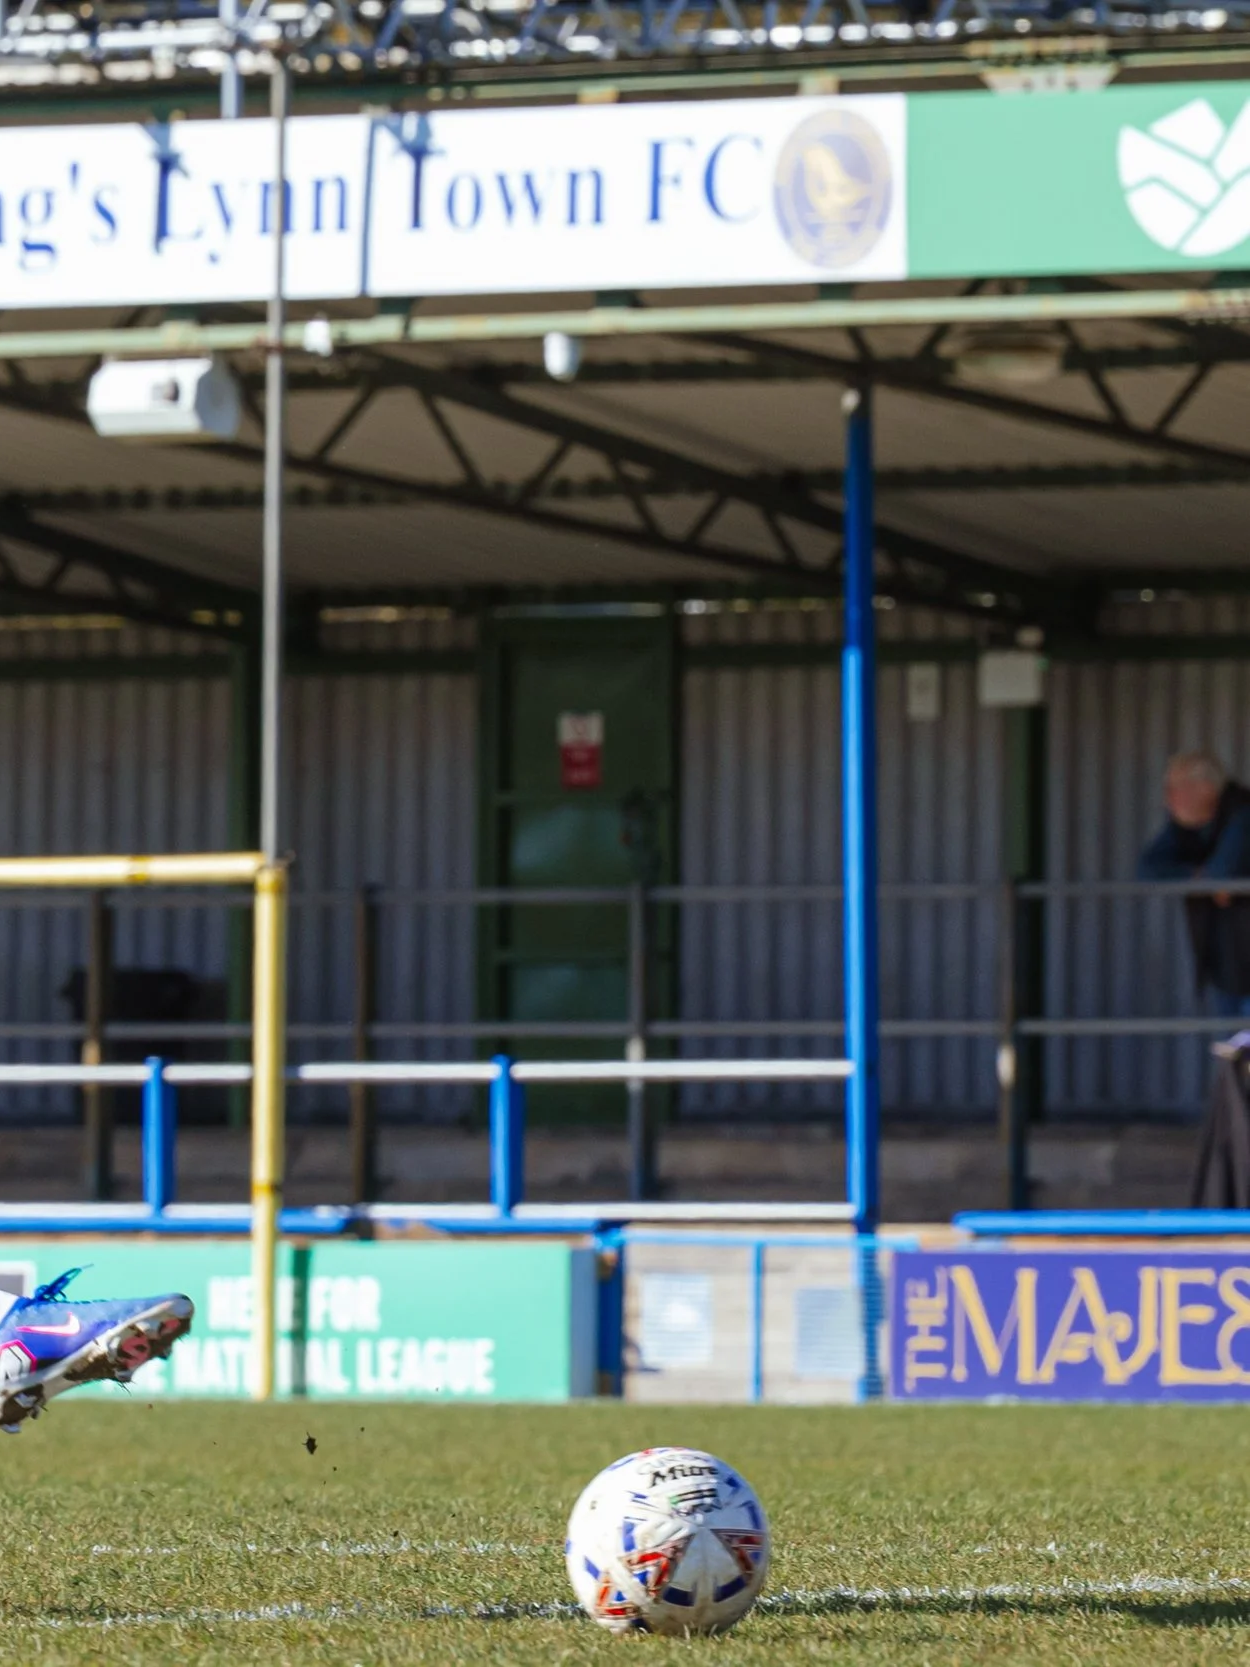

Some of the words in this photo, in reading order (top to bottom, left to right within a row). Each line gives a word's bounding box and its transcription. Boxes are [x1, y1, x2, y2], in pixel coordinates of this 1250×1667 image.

[154, 153, 350, 264] Lynn
[644, 132, 763, 225] FC
[206, 1274, 303, 1332] HEE
[306, 1274, 381, 1332] FOR
[904, 1265, 948, 1393] THE
[171, 1337, 350, 1396] NATINAL
[355, 1336, 496, 1396] LEAGUE
